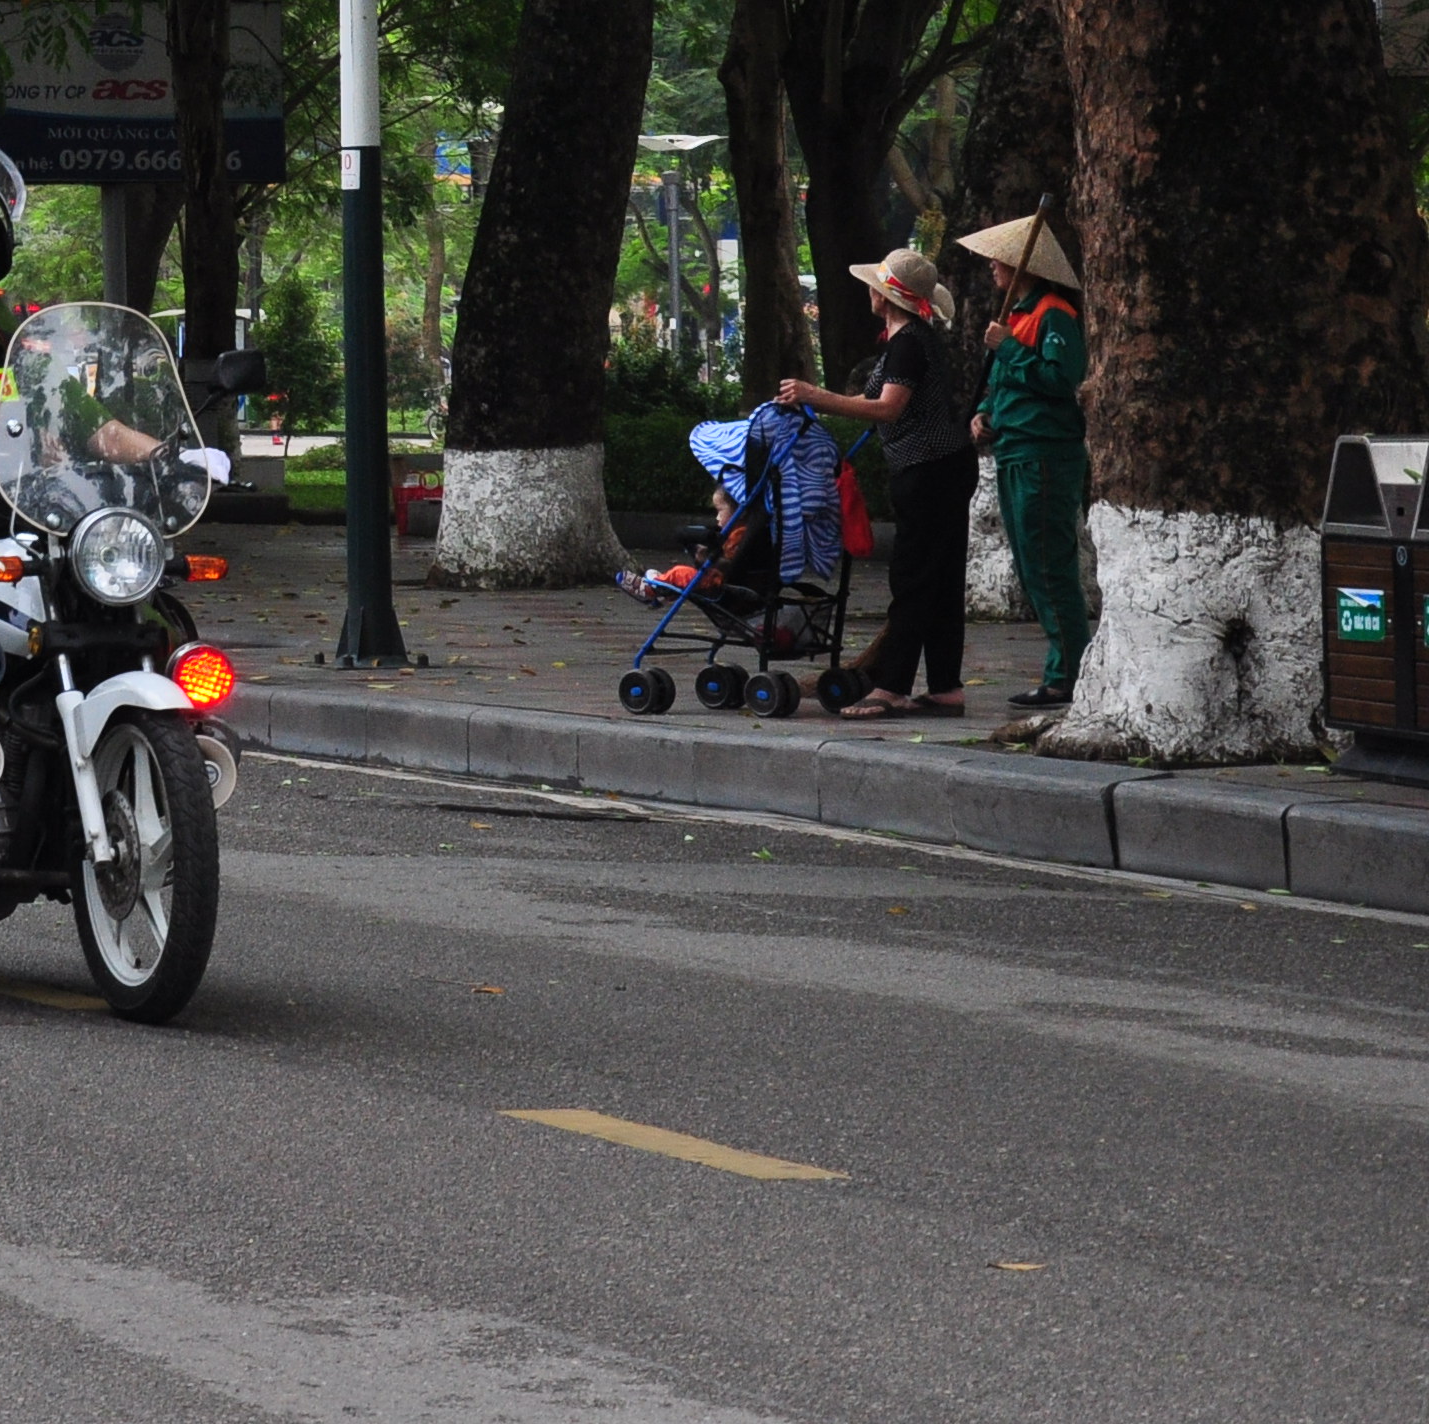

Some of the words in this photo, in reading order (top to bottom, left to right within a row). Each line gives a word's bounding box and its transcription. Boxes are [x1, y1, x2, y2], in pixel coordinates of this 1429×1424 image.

[4, 83, 40, 99] ÔNG
[45, 85, 62, 98] TY
[65, 85, 86, 99] CP
[92, 79, 168, 101] acs
[154, 124, 178, 139] CÁ
